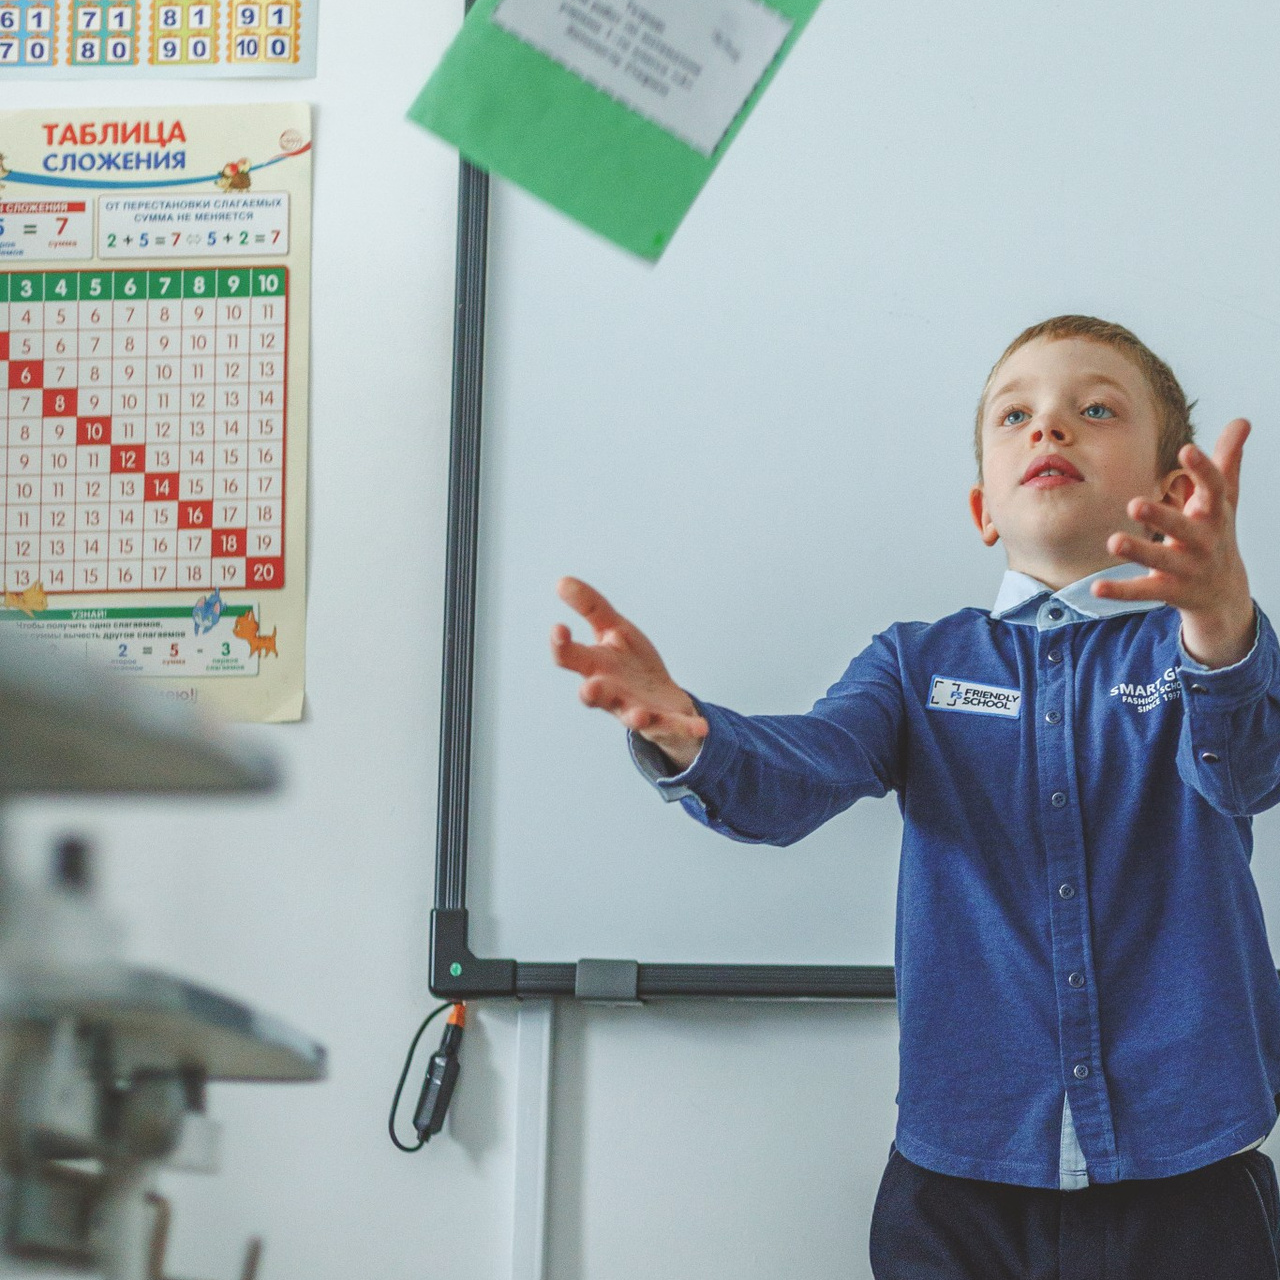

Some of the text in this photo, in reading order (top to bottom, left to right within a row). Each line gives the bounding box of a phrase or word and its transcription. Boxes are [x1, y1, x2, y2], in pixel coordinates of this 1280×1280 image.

[42, 120, 186, 147] ТАБЛИЦА
[42, 151, 186, 171] СЛОЖЕНИЯ
[21, 275, 279, 297] 3 4 5 6 7 8 9 10
[965, 688, 1020, 702] FRIENDLY
[1110, 678, 1162, 696] SMART
[962, 697, 1011, 710] SCHOOL
[1122, 691, 1159, 705] FASHION
[1137, 697, 1161, 713] SINCE
